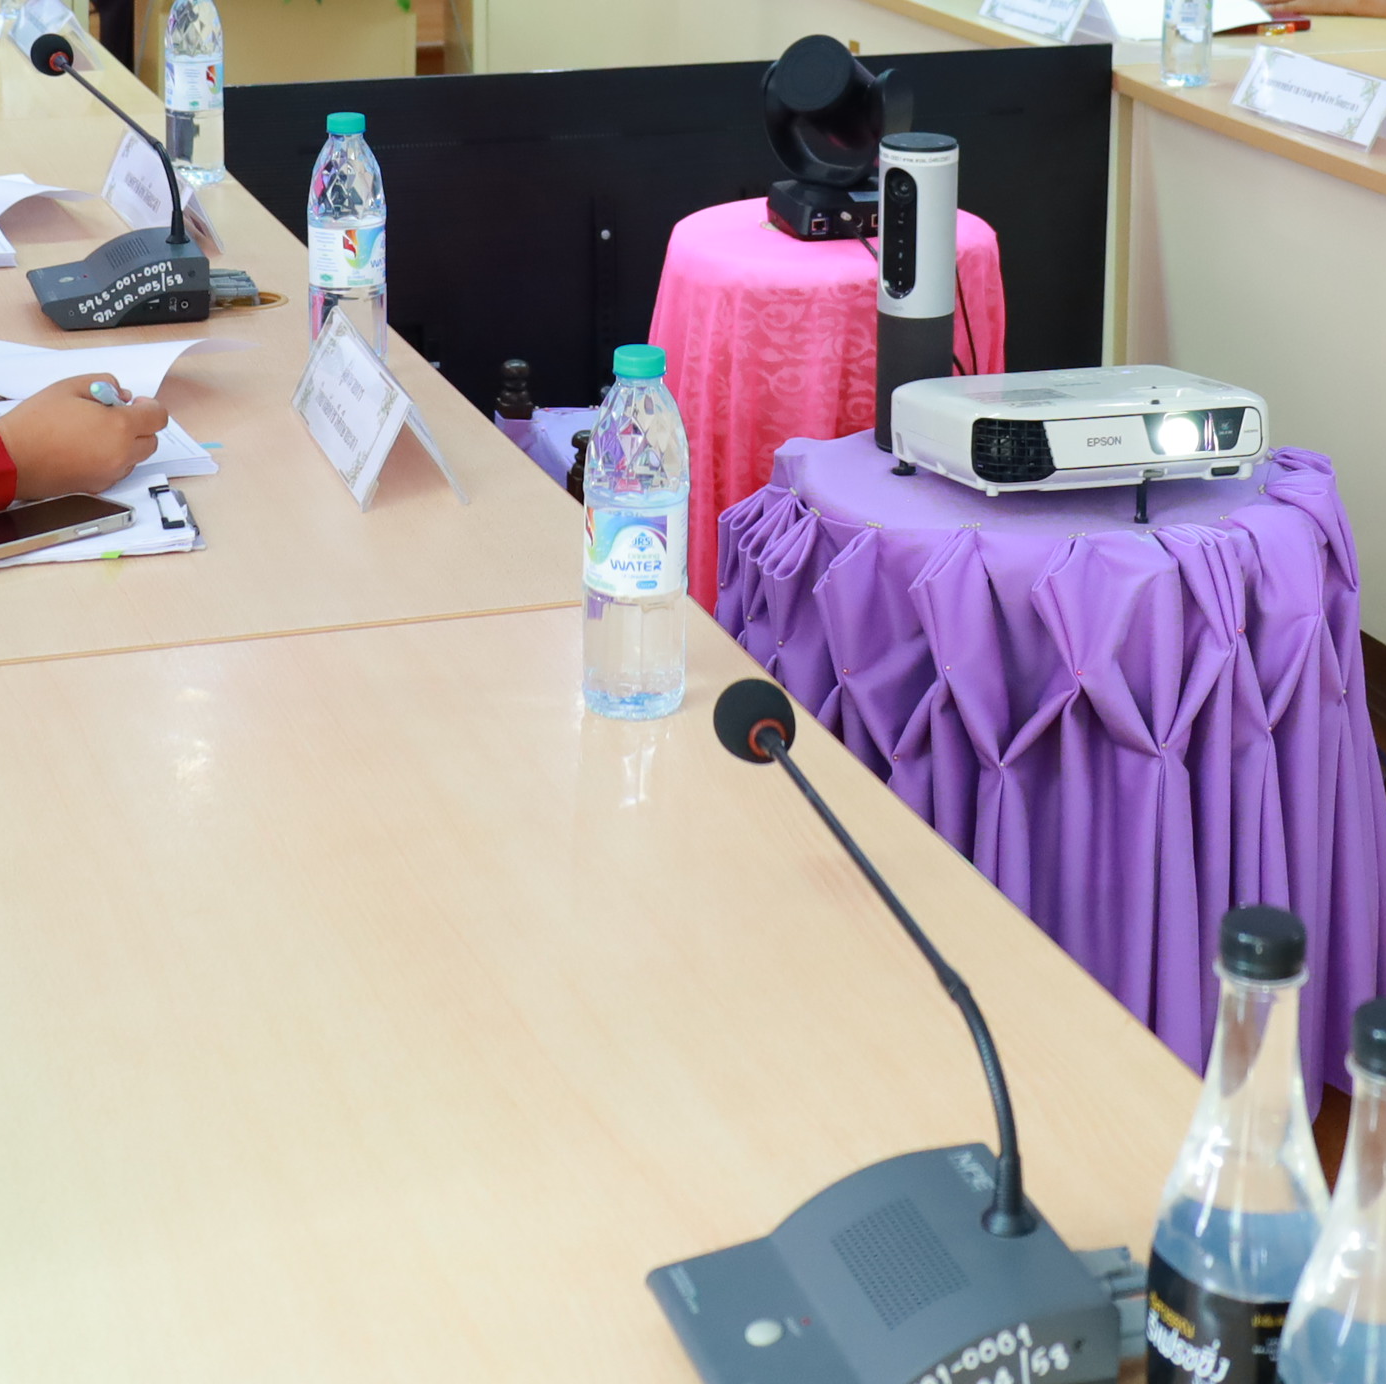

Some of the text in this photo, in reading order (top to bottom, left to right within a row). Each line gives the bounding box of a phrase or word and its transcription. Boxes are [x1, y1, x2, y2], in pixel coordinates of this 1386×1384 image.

[78, 261, 174, 315] 5965-001-0001
[1086, 435, 1123, 448] EPSON
[610, 559, 663, 573] WATER
